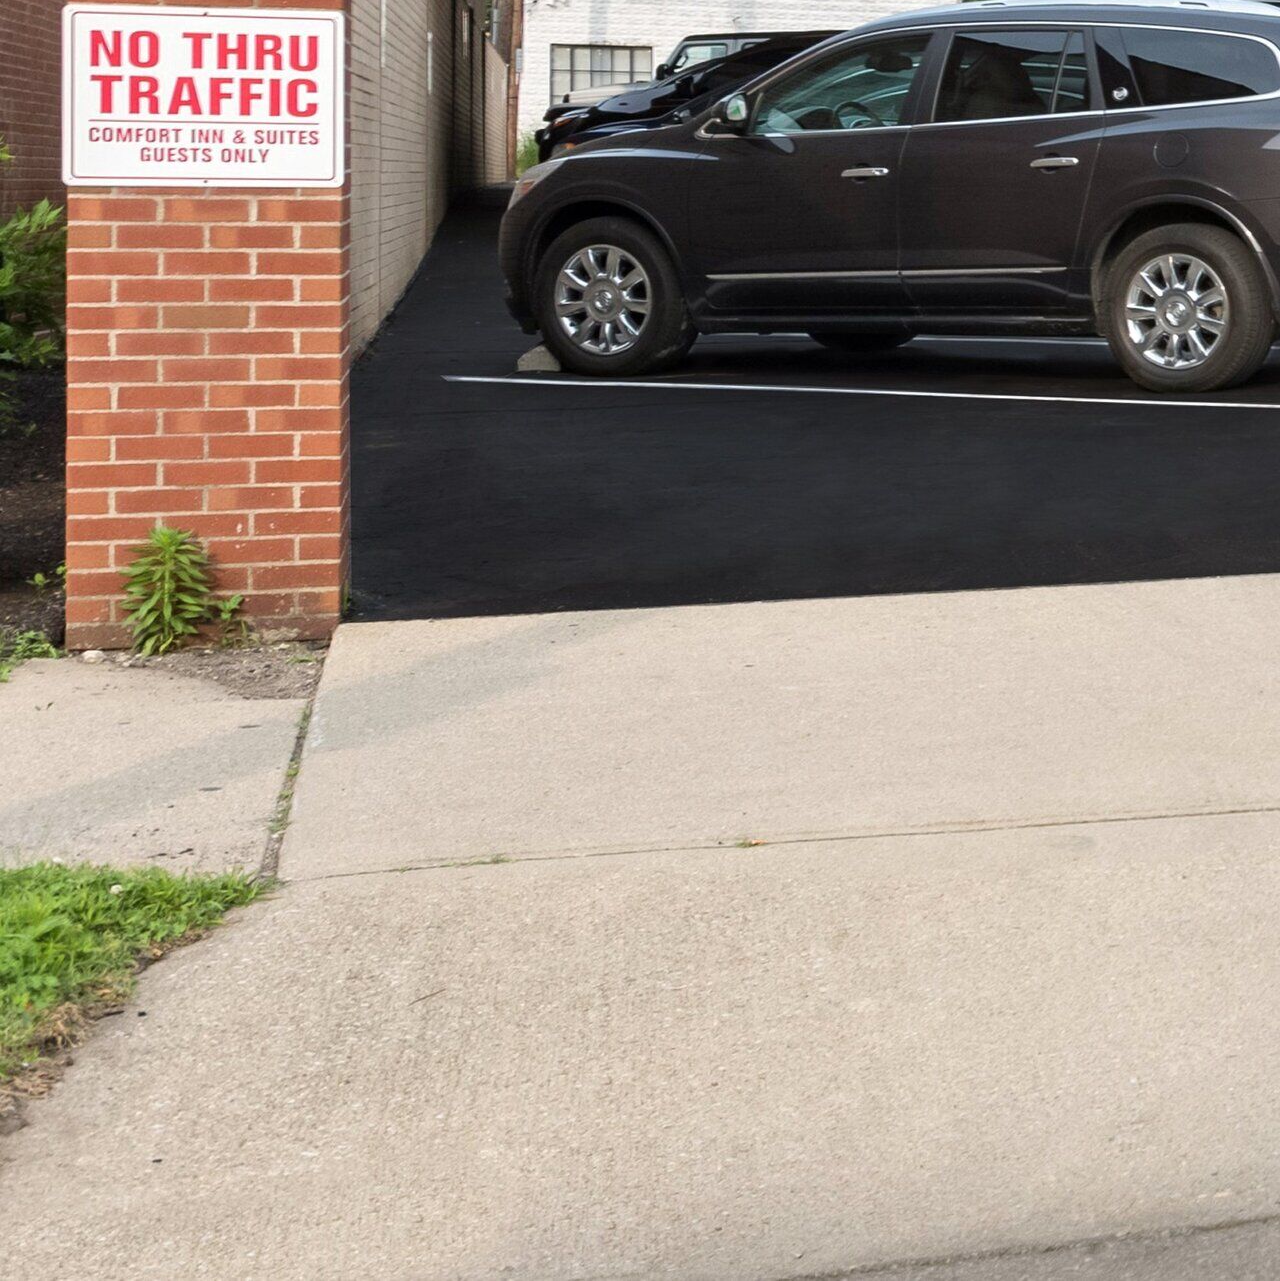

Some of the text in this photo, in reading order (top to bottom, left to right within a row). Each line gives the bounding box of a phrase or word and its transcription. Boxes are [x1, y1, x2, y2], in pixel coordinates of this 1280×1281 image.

[89, 30, 319, 72] NO THRU
[90, 74, 318, 117] TRAFFIC
[88, 127, 319, 145] COMFORT INN & SUITES
[140, 147, 269, 163] GUESTS ONLY
